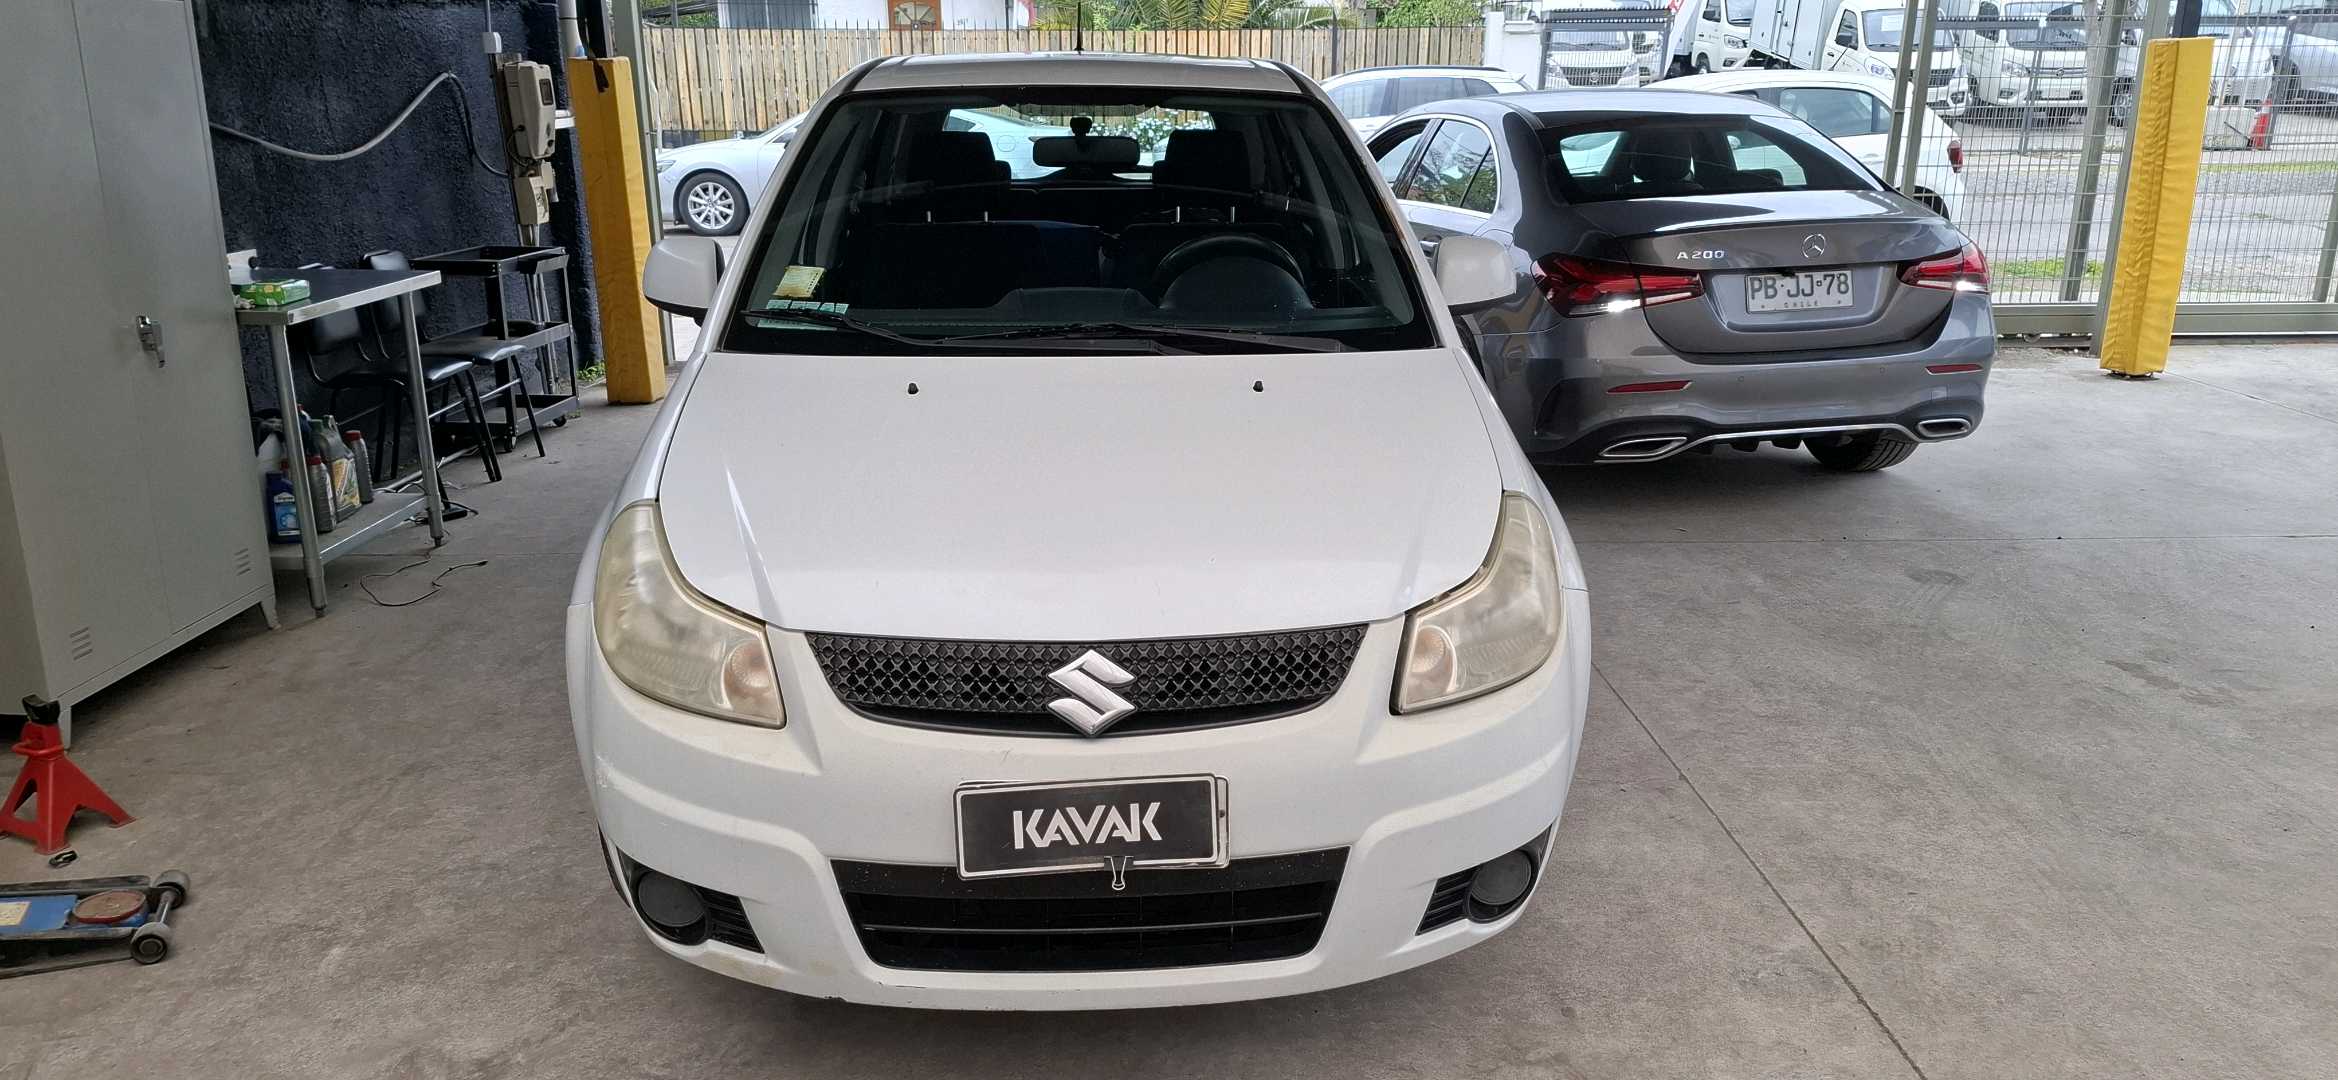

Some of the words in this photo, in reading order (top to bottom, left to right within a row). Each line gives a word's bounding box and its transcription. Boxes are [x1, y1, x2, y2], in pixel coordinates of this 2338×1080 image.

[1677, 251, 1689, 260] A
[1691, 250, 1725, 260] 200
[1013, 802, 1163, 850] KAVAK
